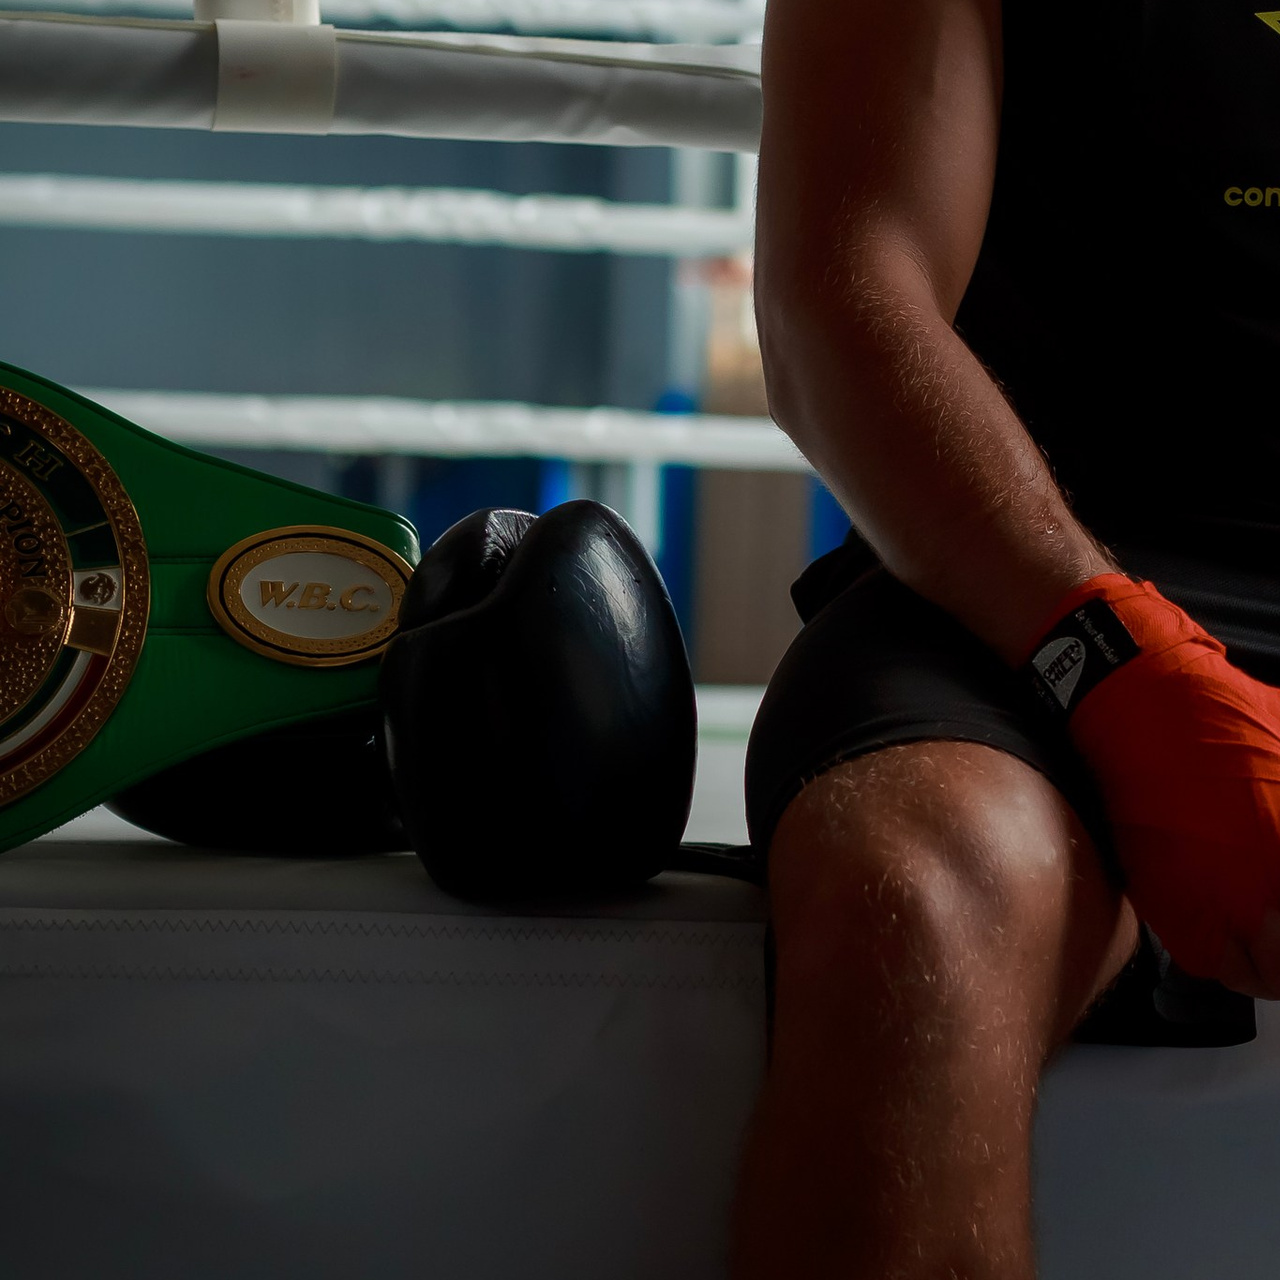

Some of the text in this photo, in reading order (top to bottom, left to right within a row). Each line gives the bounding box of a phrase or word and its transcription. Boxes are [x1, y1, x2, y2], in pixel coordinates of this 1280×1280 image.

[0, 499, 47, 579] PION
[259, 580, 381, 614] W.B.C.
[1044, 640, 1081, 679] GREEN
[1051, 656, 1082, 687] HILL
